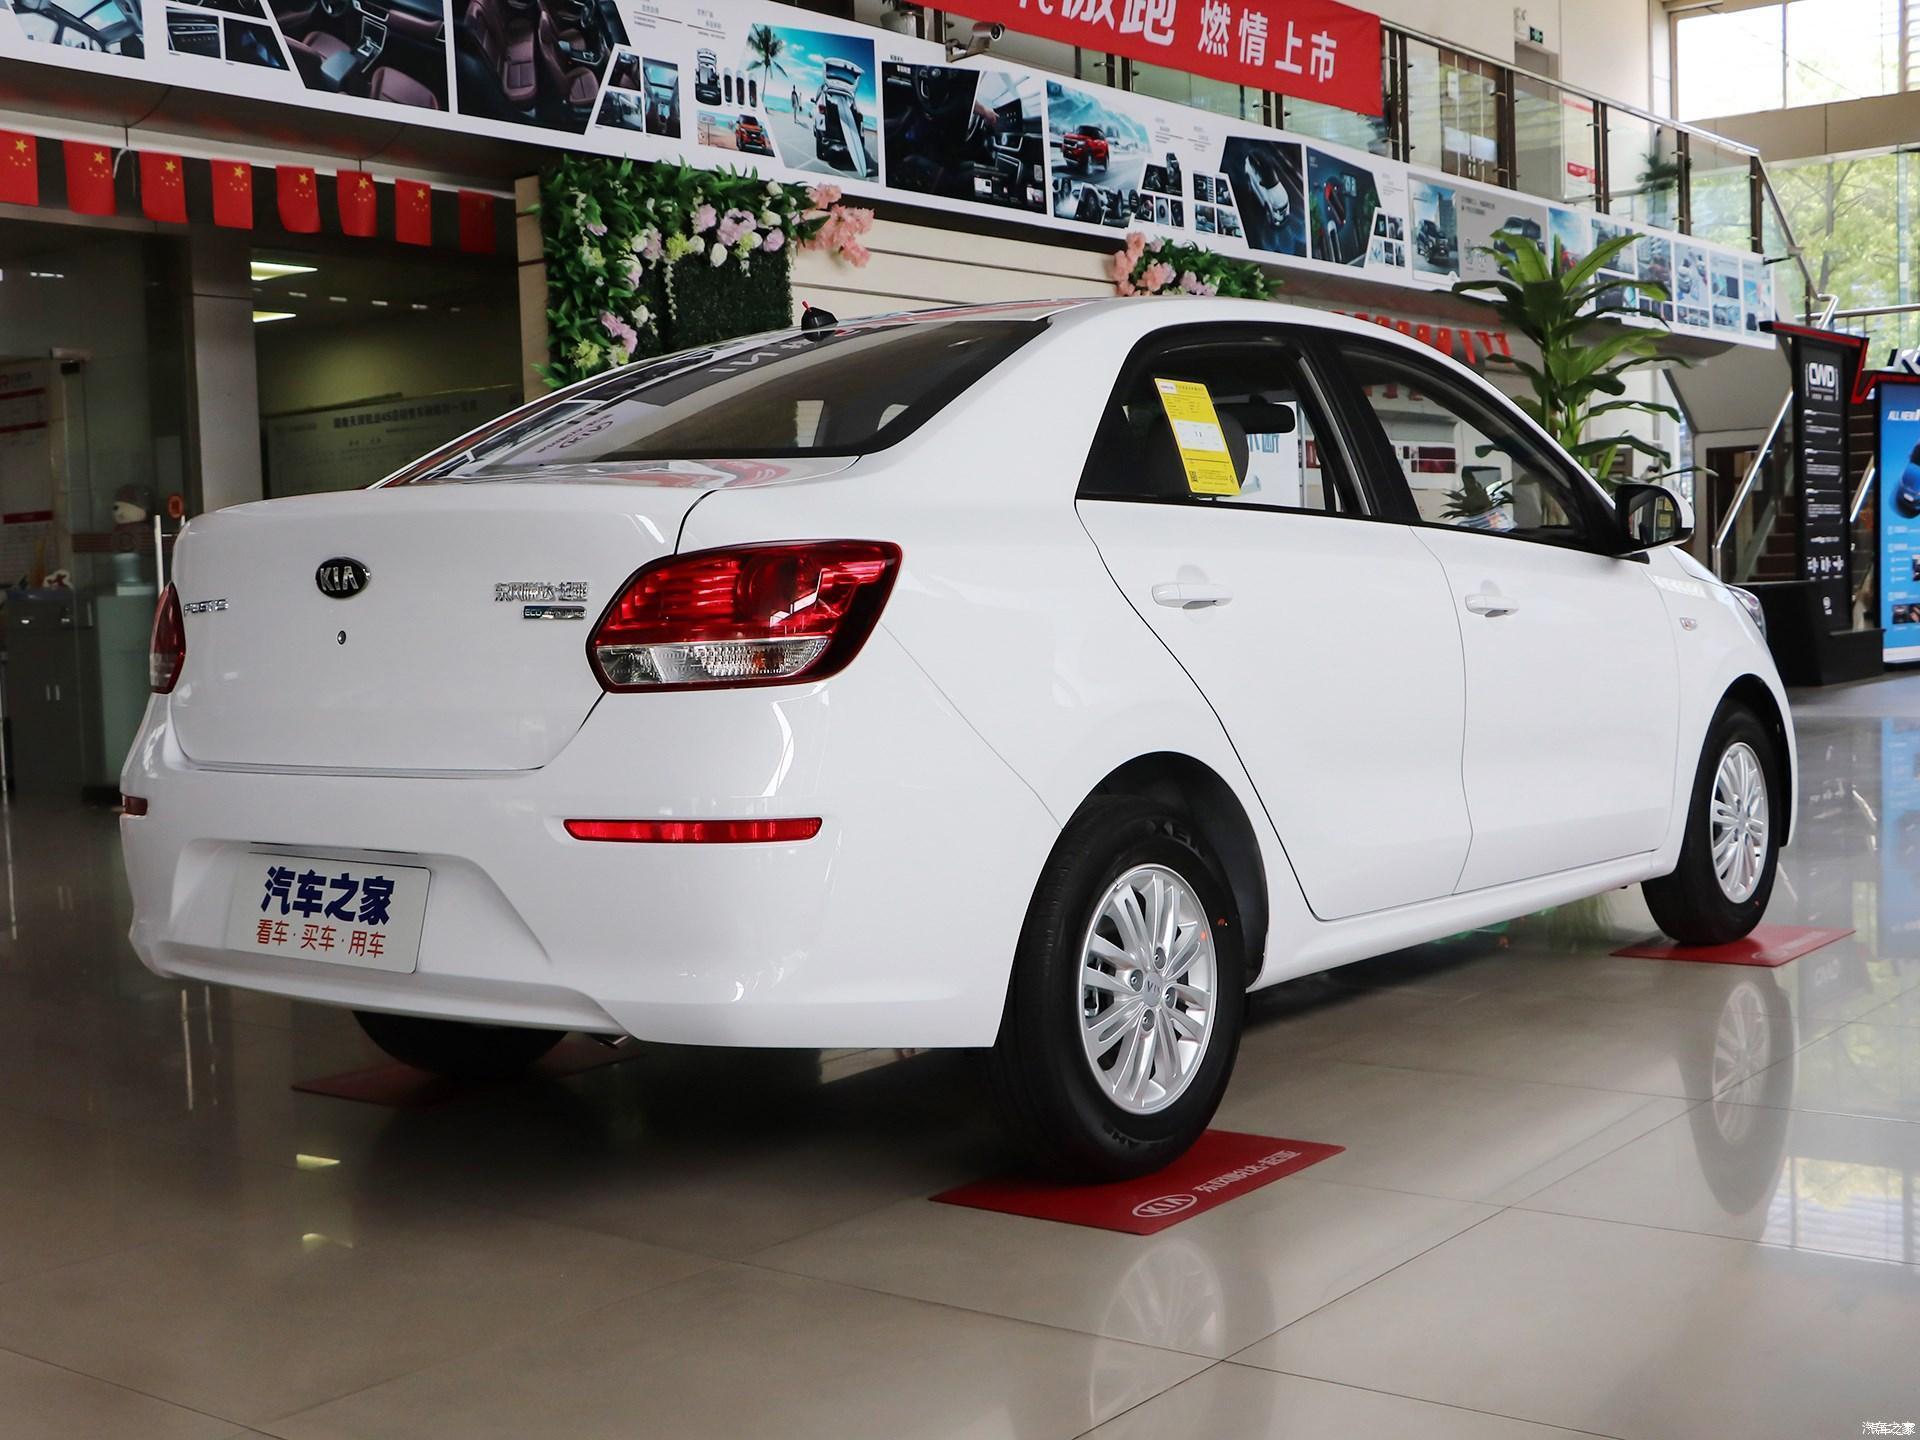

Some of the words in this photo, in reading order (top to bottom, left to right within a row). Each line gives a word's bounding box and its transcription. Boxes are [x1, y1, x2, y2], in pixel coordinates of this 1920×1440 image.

[1198, 0, 1337, 83] 燃情上市
[319, 565, 359, 591] KIA
[261, 866, 395, 926] 汽车之家
